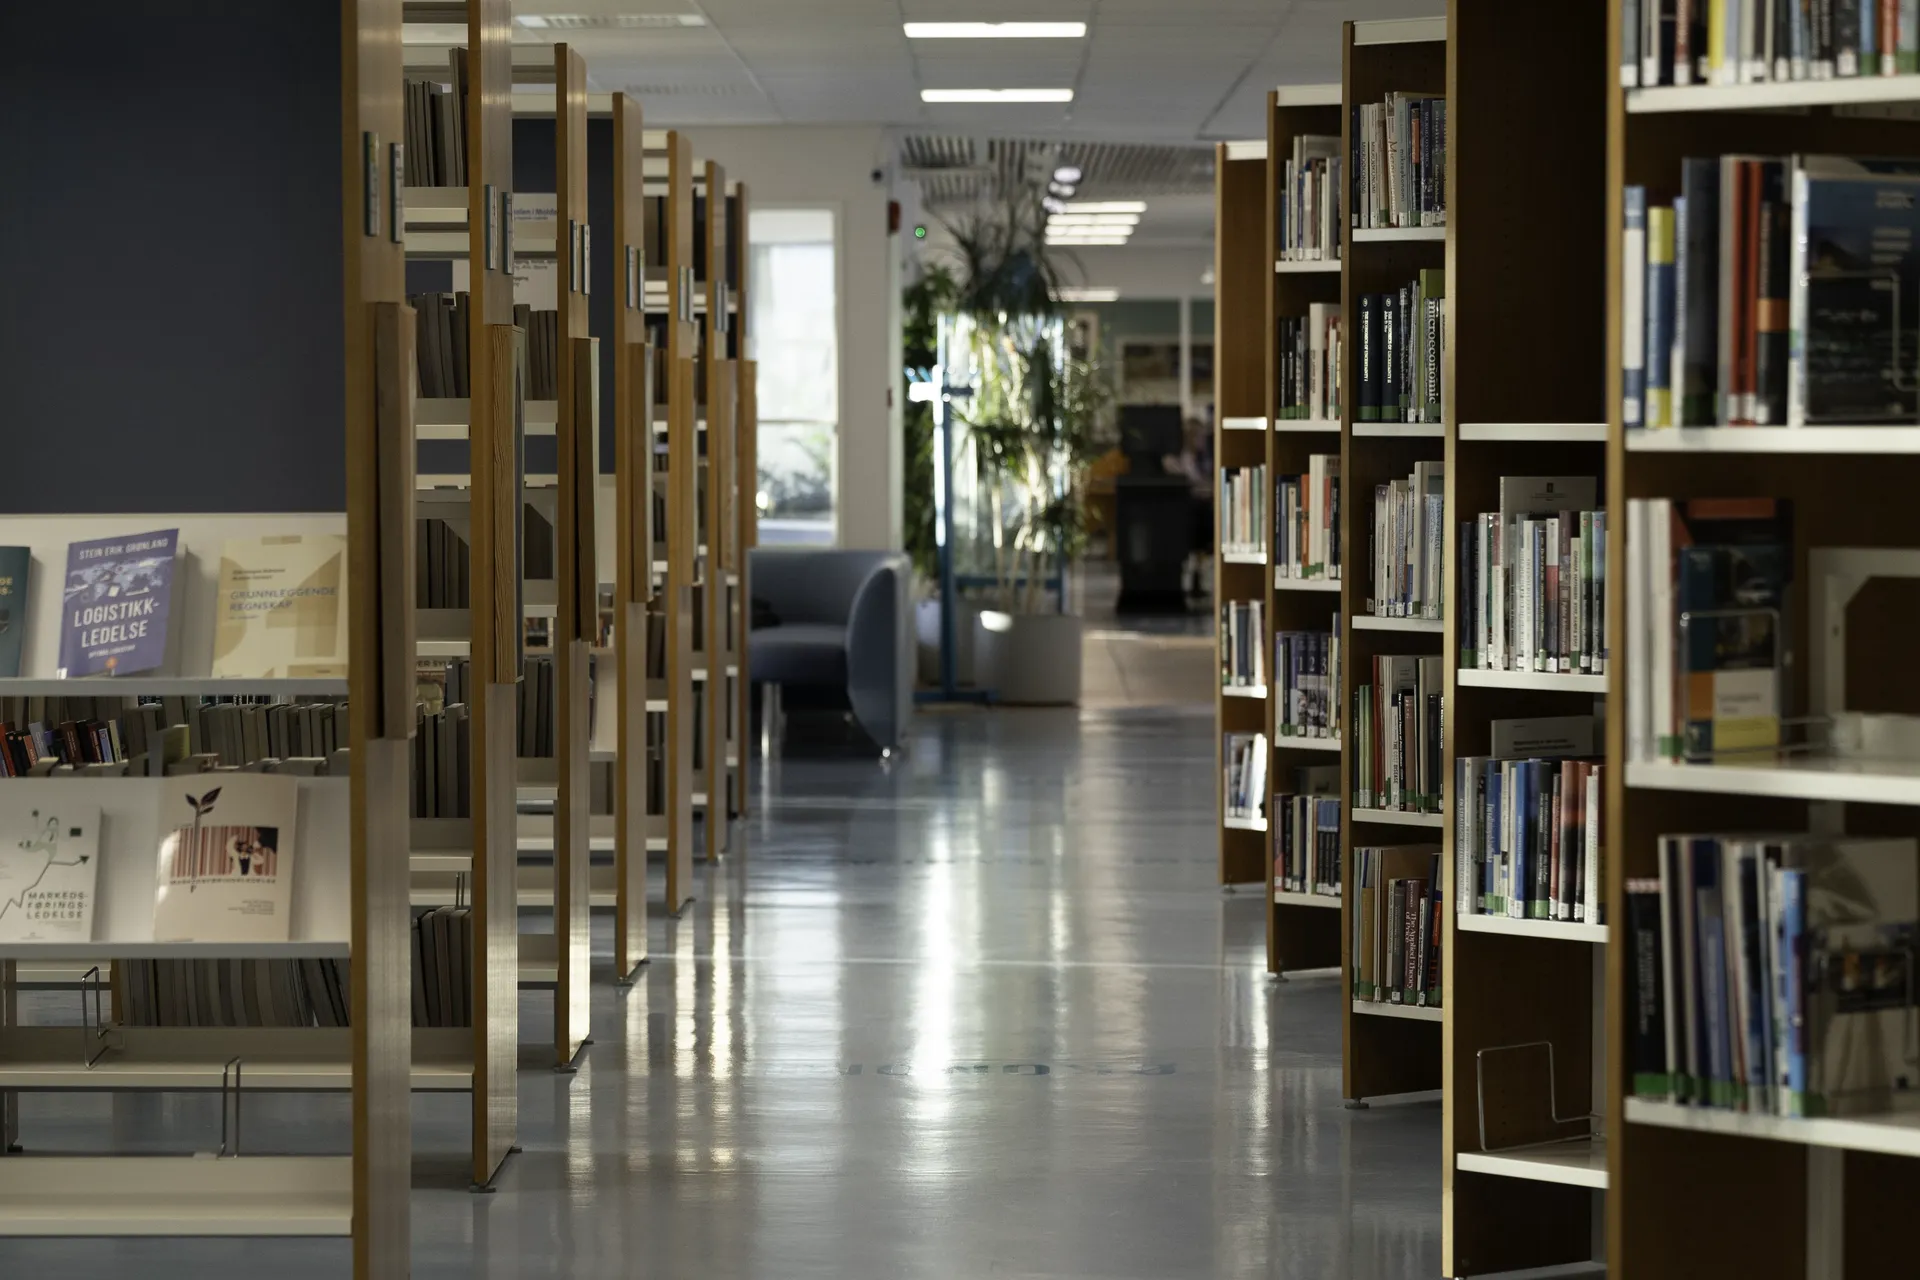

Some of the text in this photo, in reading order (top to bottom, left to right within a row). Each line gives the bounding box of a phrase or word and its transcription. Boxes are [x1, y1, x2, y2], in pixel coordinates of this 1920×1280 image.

[229, 586, 337, 600] GRUNNLEGGENDE
[229, 600, 293, 611] REGNSKAP
[81, 619, 149, 648] LEDELSE
[1309, 656, 1315, 672] 2
[1320, 657, 1327, 674] 3
[26, 911, 83, 920] LEDELSE
[1408, 929, 1416, 959] Applied
[1407, 960, 1416, 990] Theory
